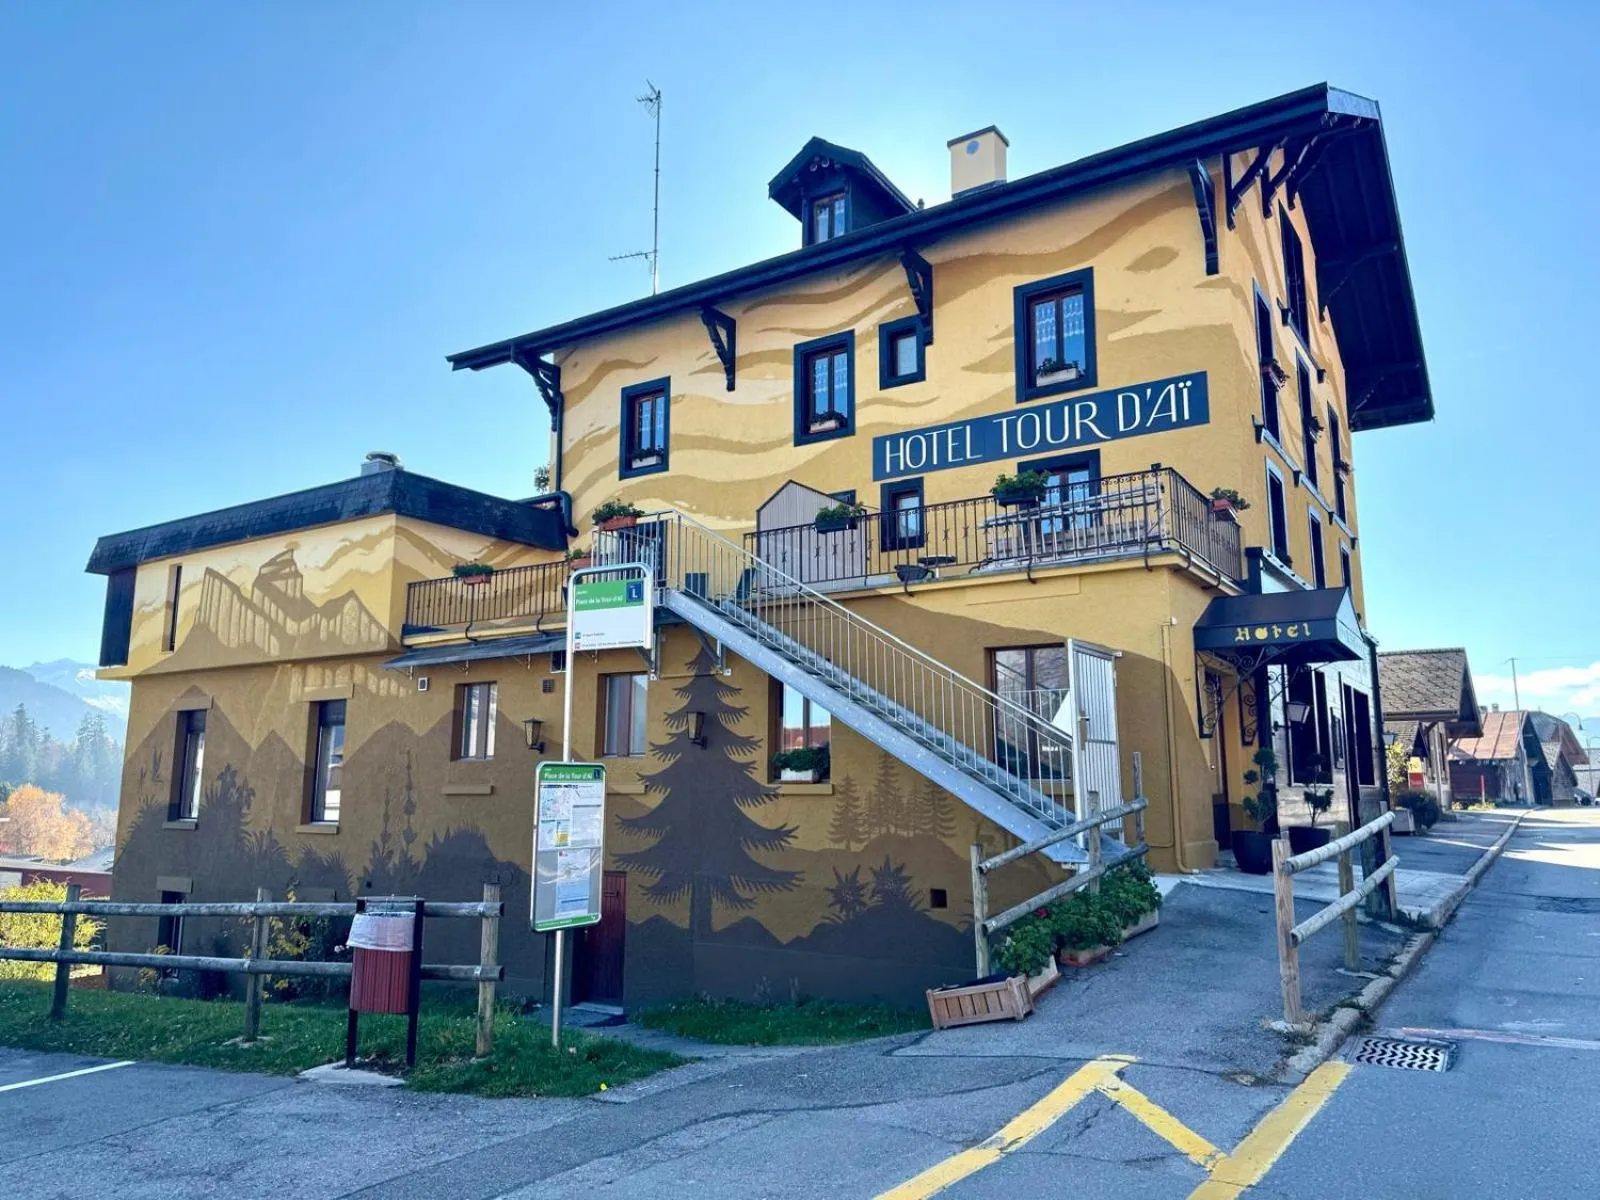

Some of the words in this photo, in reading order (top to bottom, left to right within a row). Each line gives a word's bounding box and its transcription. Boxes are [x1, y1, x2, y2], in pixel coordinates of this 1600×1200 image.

[886, 425, 982, 473] HOTEL
[993, 402, 1111, 453] TOUR
[1117, 380, 1193, 432] D'AÏ
[1234, 622, 1311, 642] Hotel
